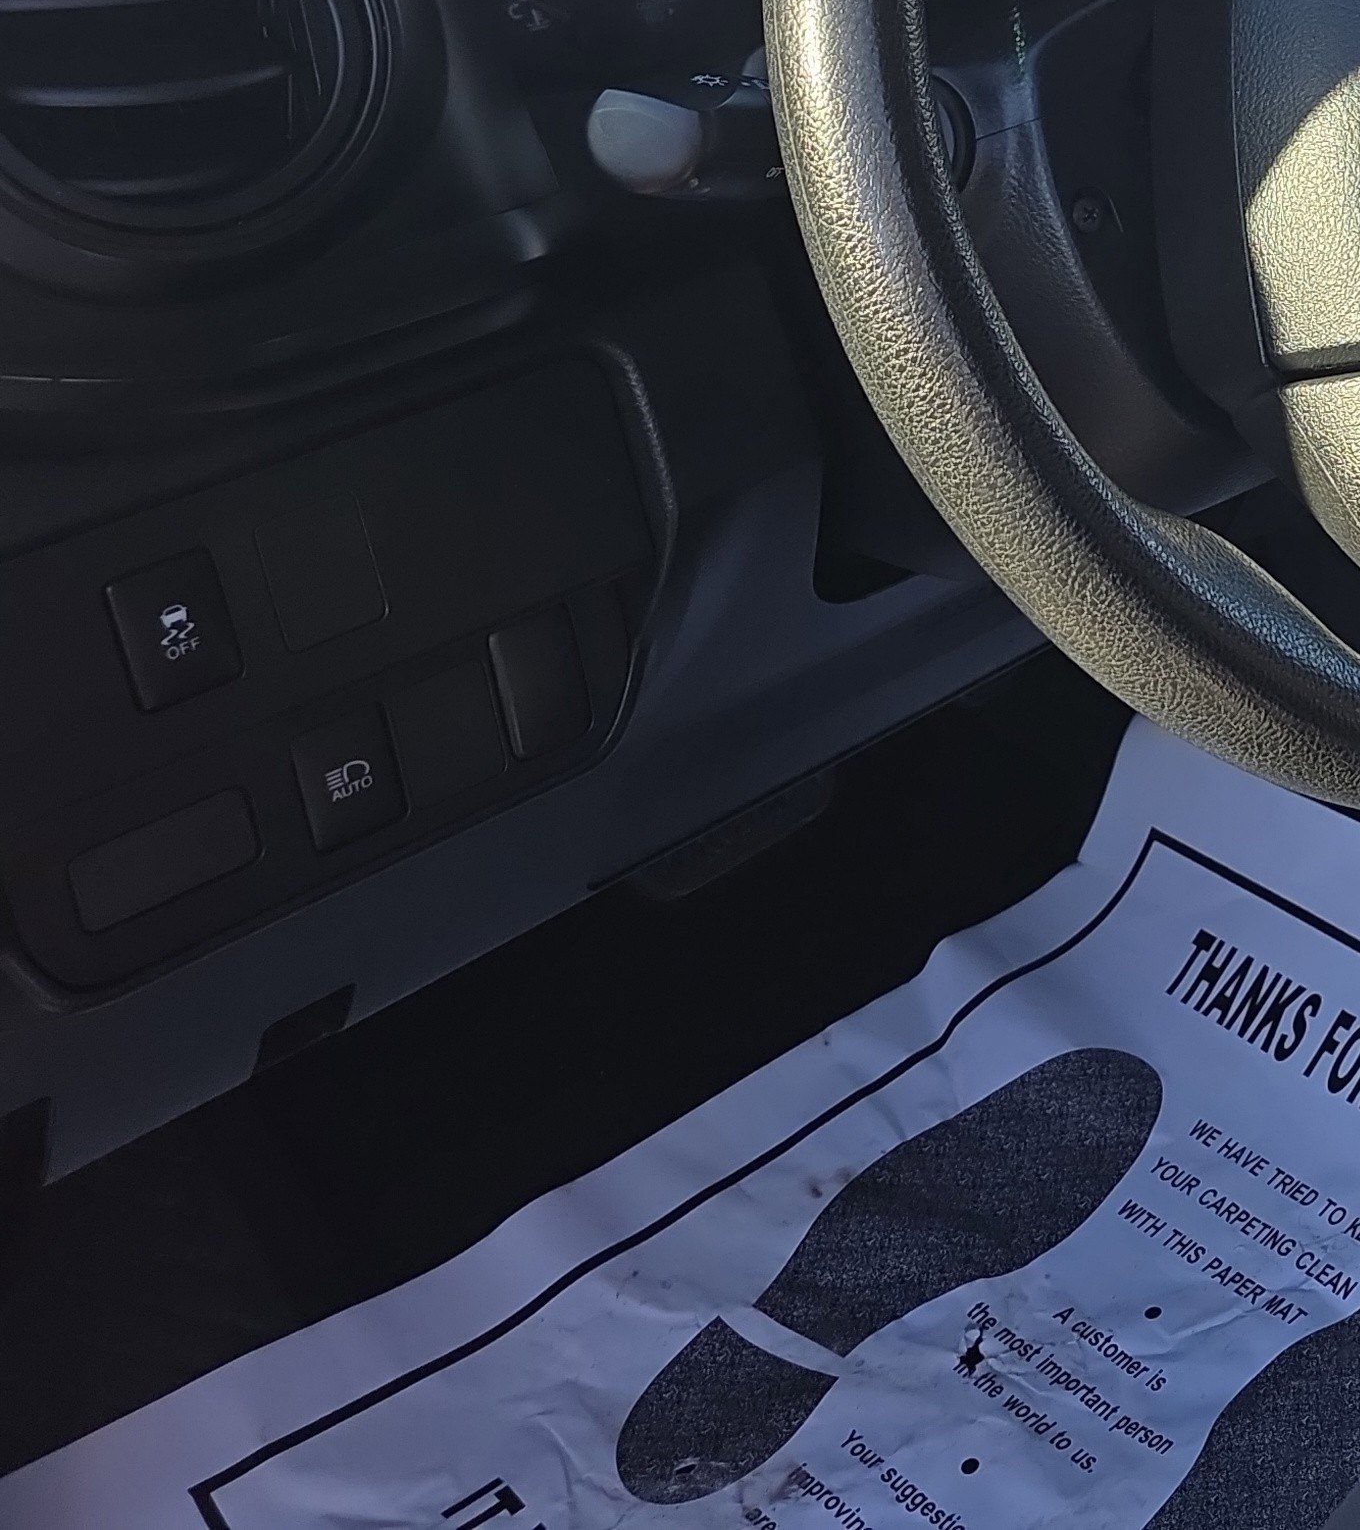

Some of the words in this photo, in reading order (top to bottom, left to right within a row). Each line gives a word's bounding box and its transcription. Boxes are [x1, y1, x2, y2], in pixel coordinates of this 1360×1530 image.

[167, 636, 200, 660] OFF
[332, 775, 373, 802] AUTO
[1165, 929, 1323, 1062] THANKS
[1189, 1119, 1222, 1148] WE
[1217, 1138, 1270, 1177] HAVE
[1266, 1167, 1319, 1206] TRIED
[1318, 1198, 1347, 1226] TO
[1117, 1198, 1168, 1238] WITH
[1162, 1228, 1206, 1265] THIS
[1201, 1256, 1267, 1305] PAPER
[1261, 1294, 1309, 1325] MAT
[1150, 1156, 1201, 1196] YOUR
[1198, 1188, 1297, 1257] CARPETING
[1294, 1251, 1359, 1301] CLEAN
[967, 1302, 998, 1331] the
[993, 1327, 1044, 1363] most
[1036, 1354, 1121, 1421] important
[1108, 1414, 1175, 1455] person
[1053, 1306, 1076, 1325] A
[1071, 1320, 1150, 1380] customer
[1145, 1369, 1167, 1393] is
[840, 1429, 885, 1469] Your
[973, 1372, 1005, 1399] the
[1002, 1394, 1058, 1436] world
[1049, 1430, 1072, 1451] to
[441, 1477, 526, 1530] IT
[787, 1462, 873, 1530] improvin
